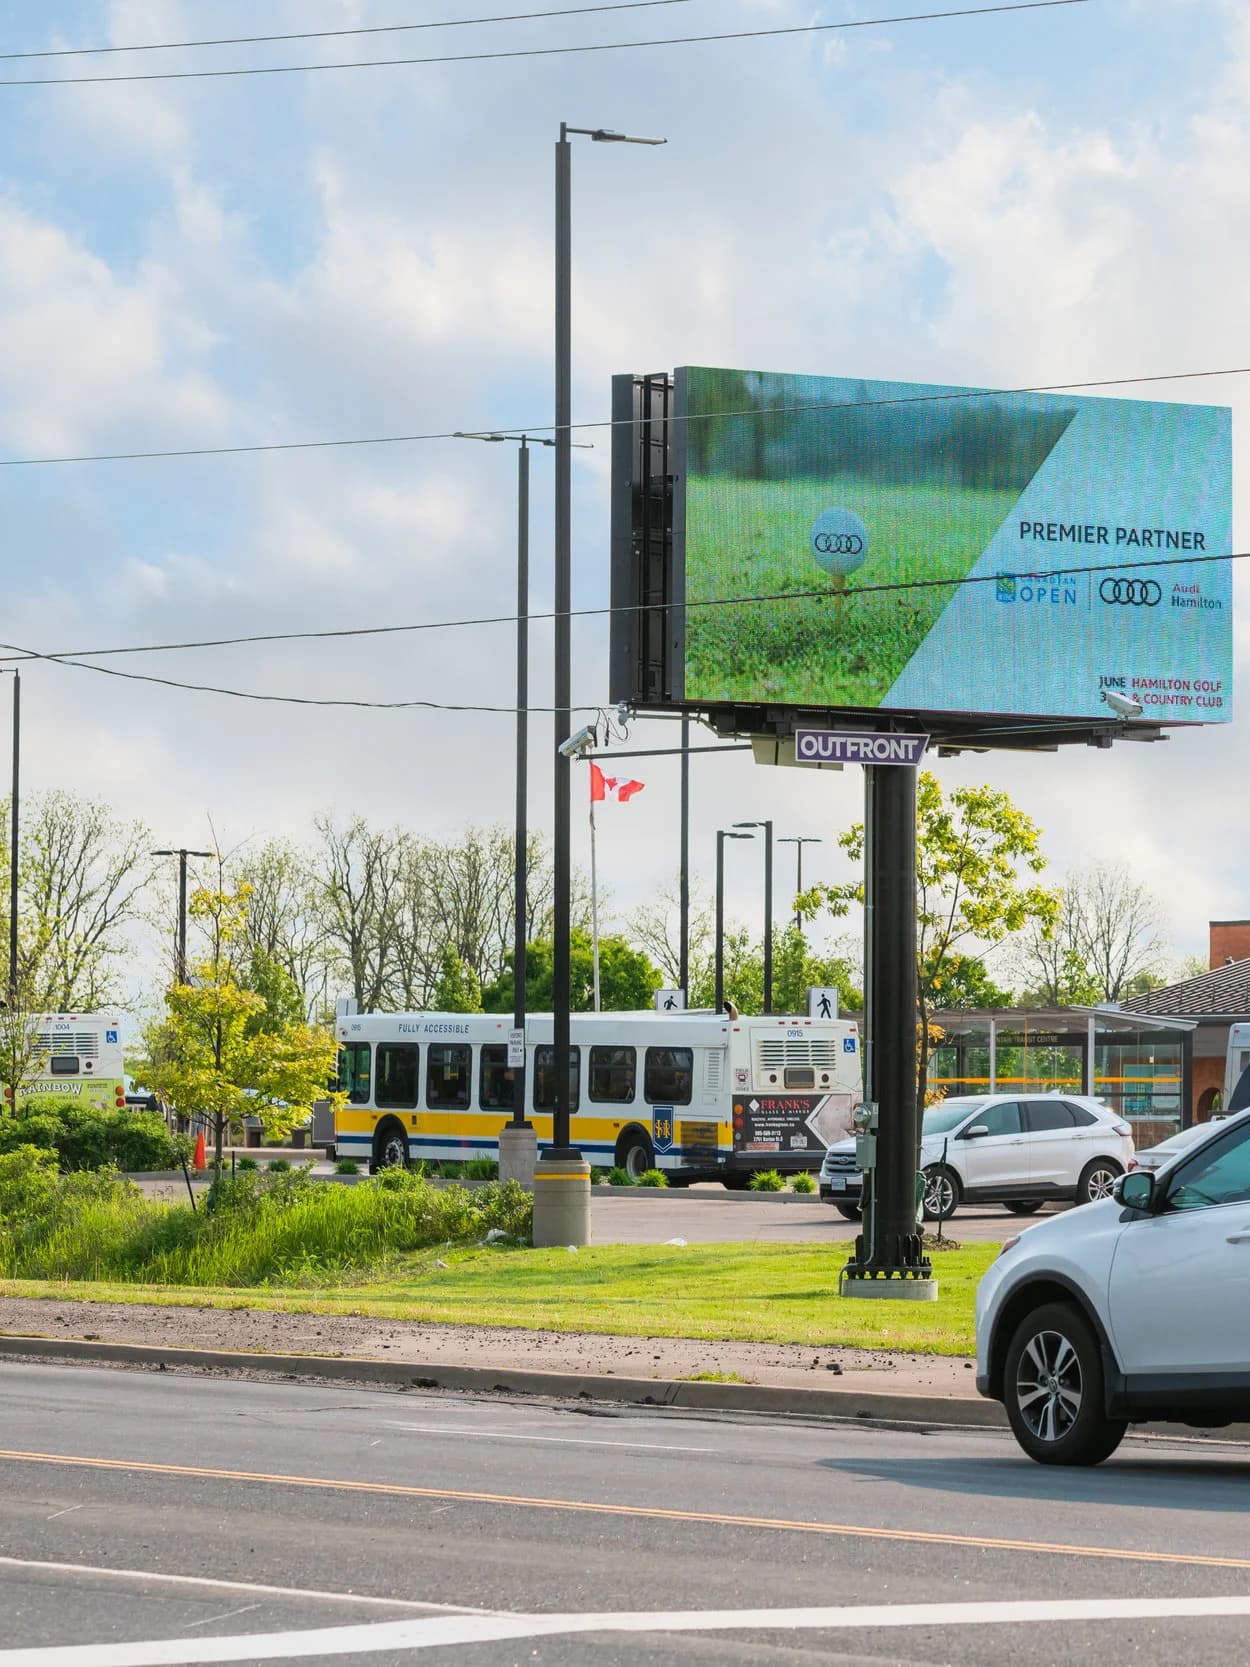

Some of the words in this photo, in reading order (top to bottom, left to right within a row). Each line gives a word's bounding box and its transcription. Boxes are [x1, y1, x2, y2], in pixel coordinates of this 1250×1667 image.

[1019, 521, 1109, 545] PREMIER
[1115, 527, 1206, 550] PARTNER
[1020, 586, 1076, 604] OPEN
[1173, 583, 1199, 594] Audi
[1171, 595, 1222, 609] Hamilton
[1099, 676, 1126, 689] JUNE
[1132, 678, 1190, 691] HAMILTON
[1193, 680, 1222, 692] GOLF
[1143, 693, 1193, 706] COUNTRY
[1196, 695, 1222, 708] CLUB
[800, 735, 918, 760] OUTFRONT
[55, 1023, 70, 1031] 1004
[398, 1024, 420, 1033] FULLY
[424, 1024, 470, 1034] ACCESSIBLE
[787, 1029, 804, 1038] 0915
[760, 1098, 810, 1109] FRANK'S
